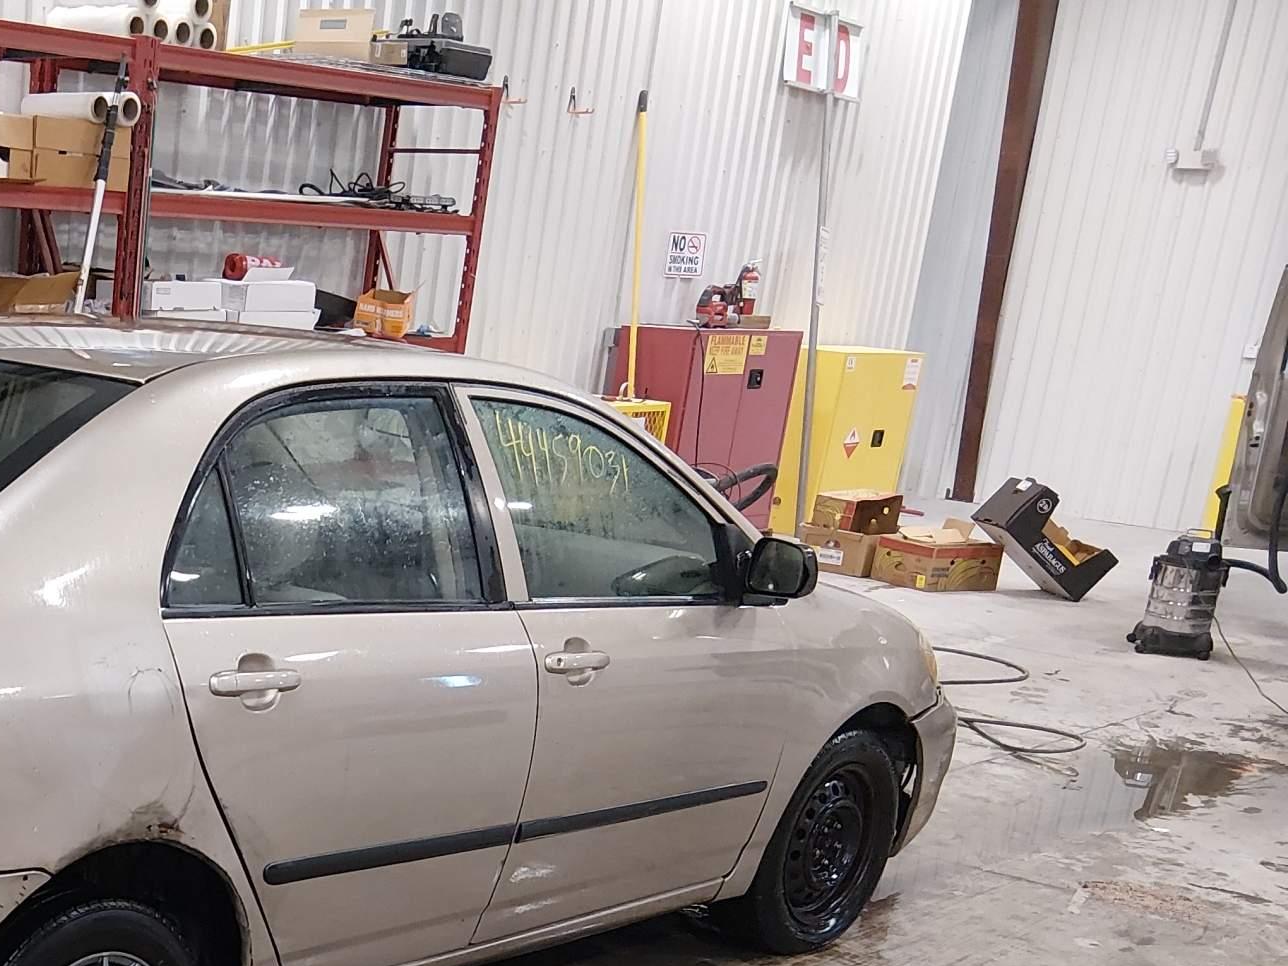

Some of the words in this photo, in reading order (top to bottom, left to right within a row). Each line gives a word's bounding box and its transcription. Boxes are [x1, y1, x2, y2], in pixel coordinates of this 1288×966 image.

[796, 12, 815, 85] E
[671, 234, 687, 252] NO
[669, 254, 700, 266] SMOKING
[494, 409, 630, 498] 44459031
[1034, 542, 1067, 574] ASPARAGUS
